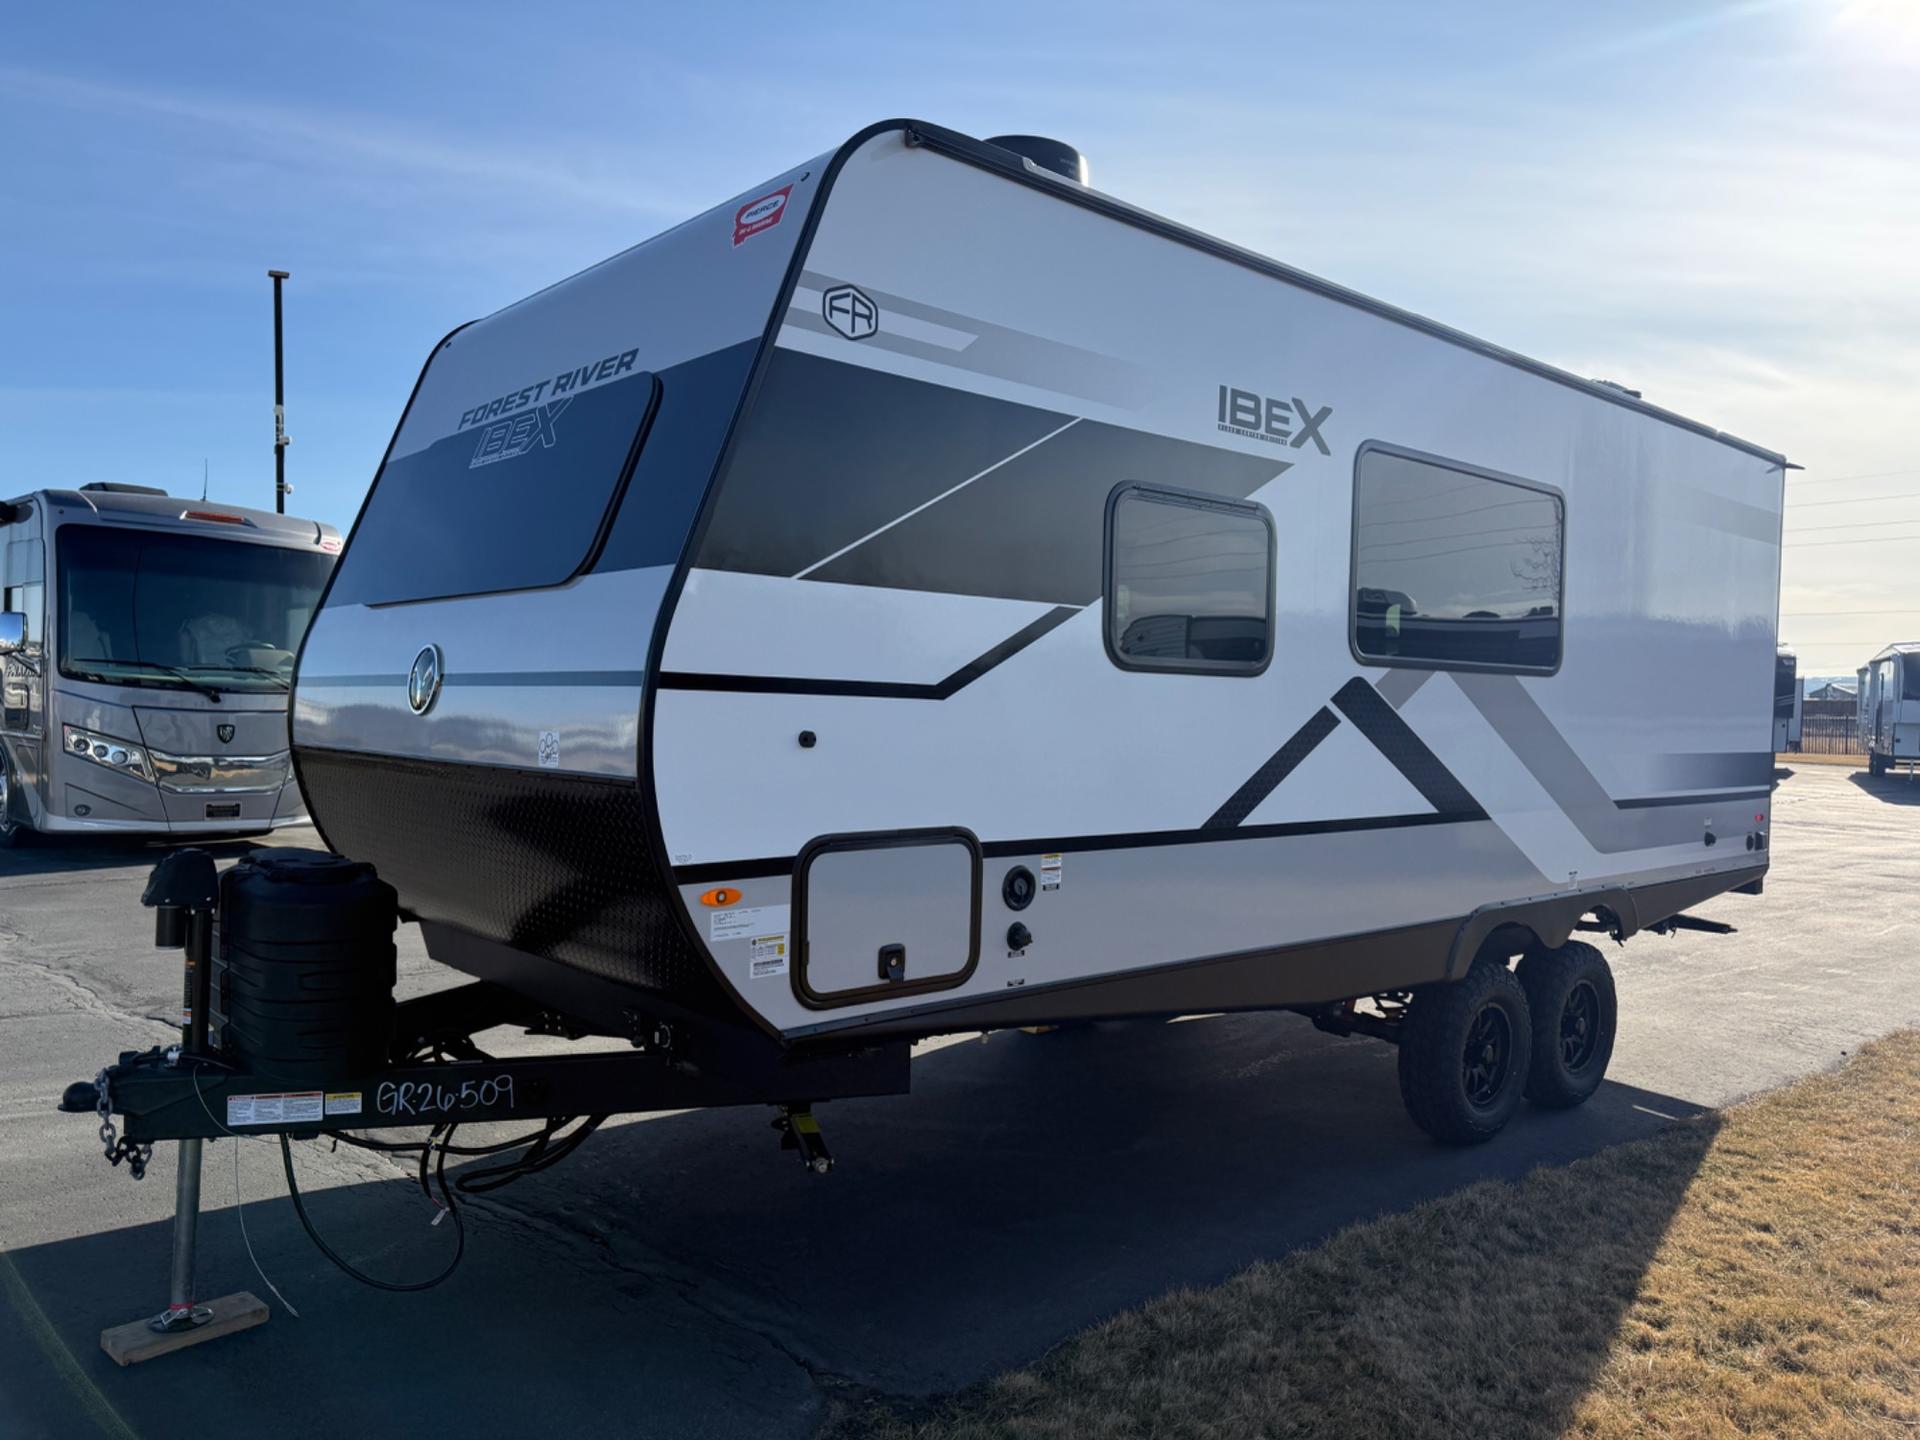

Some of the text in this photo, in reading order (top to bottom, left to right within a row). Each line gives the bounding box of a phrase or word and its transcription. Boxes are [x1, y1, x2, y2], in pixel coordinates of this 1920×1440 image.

[456, 347, 640, 431] FOREST RIVER
[1217, 383, 1334, 457] IBEX
[470, 394, 576, 466] IBEX
